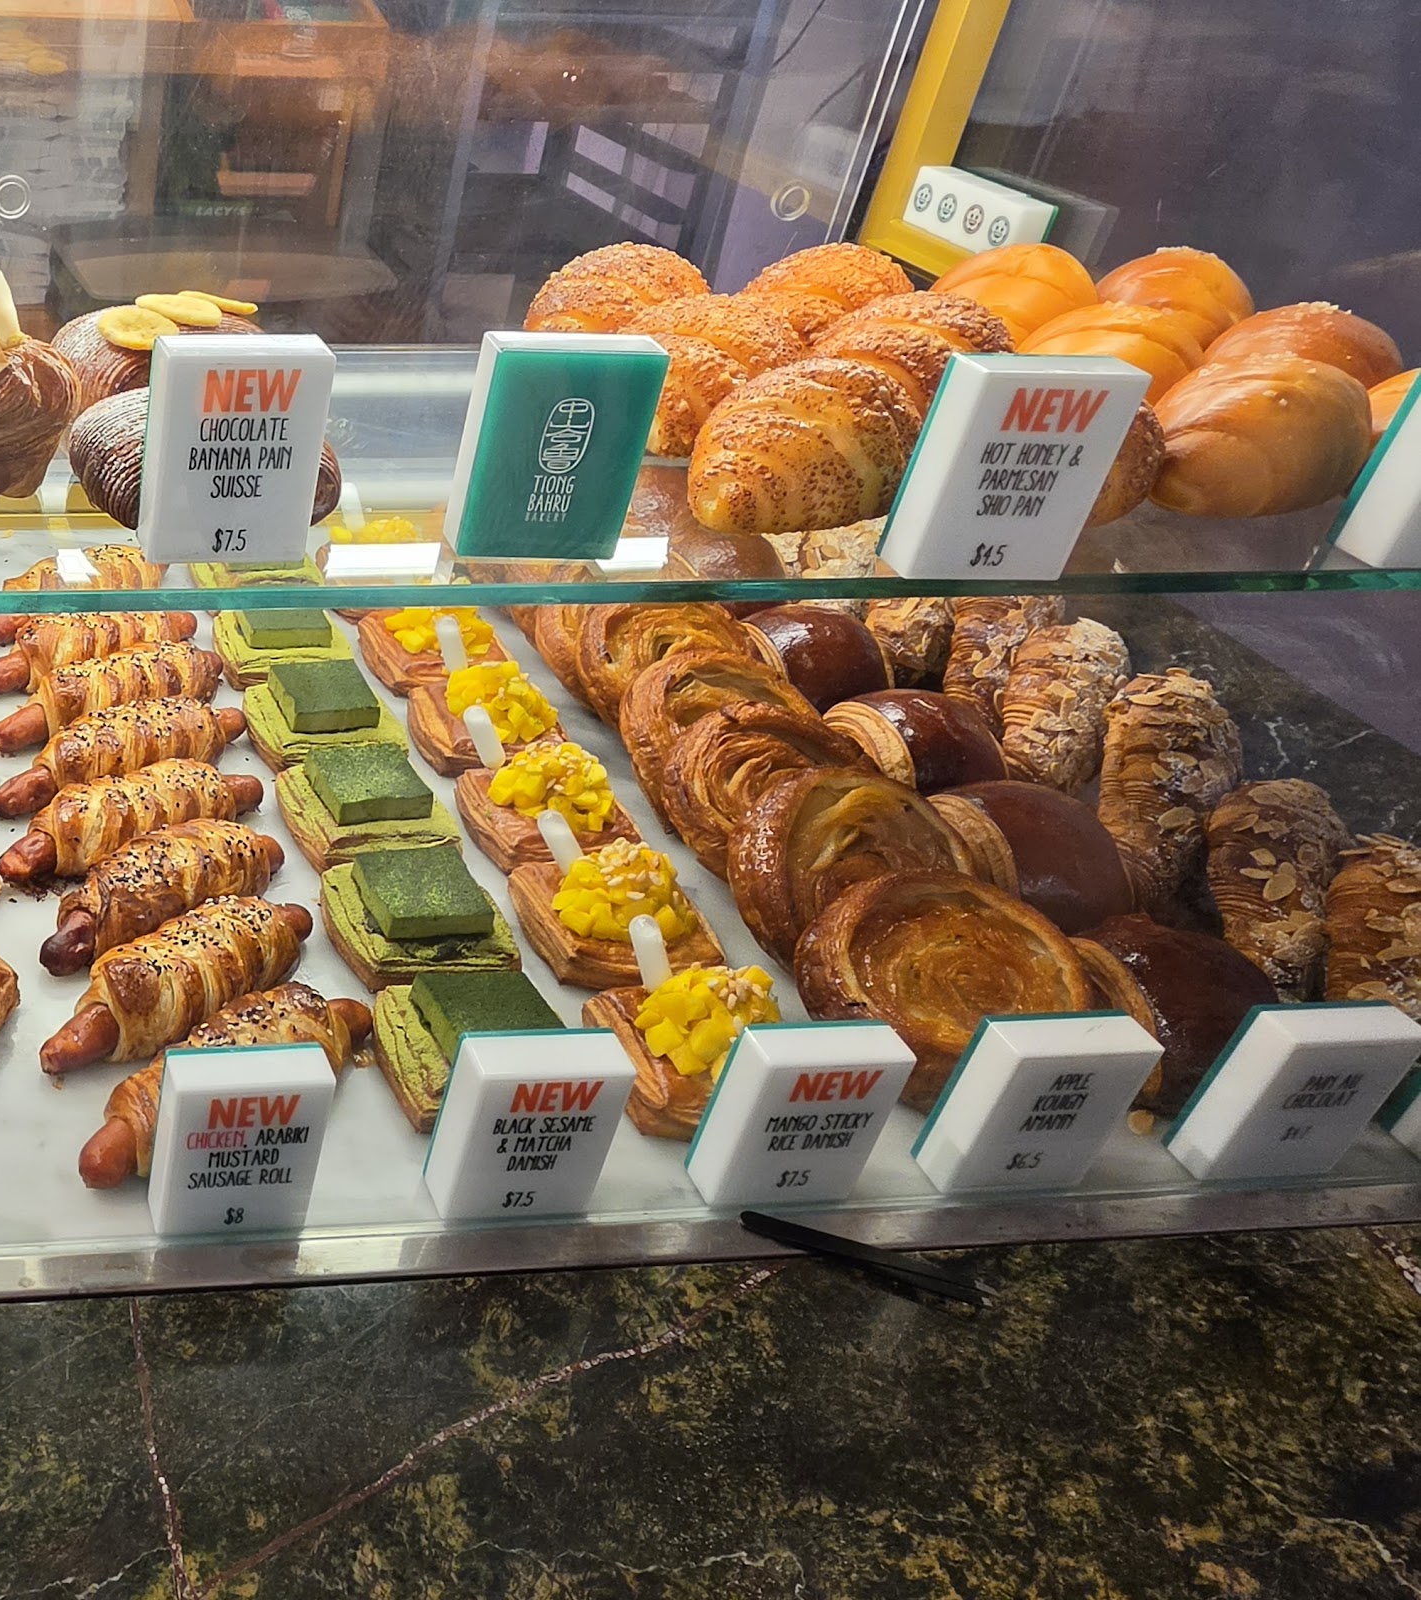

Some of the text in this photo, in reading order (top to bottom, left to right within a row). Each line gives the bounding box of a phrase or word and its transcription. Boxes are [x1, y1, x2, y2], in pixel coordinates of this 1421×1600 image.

[202, 368, 302, 413] NEW
[999, 387, 1111, 433] NEW
[200, 417, 290, 442] CHOCOLATE
[188, 446, 293, 471] BANANA PAIN
[980, 442, 1084, 467] HOT HONEY &
[210, 474, 263, 499] SUISSE
[534, 474, 577, 494] TIONG
[978, 469, 1059, 491] PARMESAN
[527, 493, 572, 513] BAHRU
[976, 495, 1046, 517] SHIO PAN
[524, 511, 568, 523] BAKERY
[212, 528, 247, 553] $7.5
[969, 543, 1008, 567] $4.5
[789, 1069, 883, 1103] NEW
[1049, 1073, 1095, 1091] APPLE
[509, 1080, 604, 1113] NEW
[1032, 1093, 1089, 1112] KOUIGN
[207, 1094, 301, 1130] NEW
[1020, 1113, 1077, 1131] AMANN
[492, 1115, 597, 1135] BLACK SESAME
[765, 1112, 874, 1133] MANGO STICKY
[255, 1126, 310, 1146] ARABIKI
[496, 1136, 571, 1154] & MATCHA
[767, 1132, 854, 1151] RICE DANISH
[208, 1148, 280, 1168] MUSTARD
[506, 1154, 558, 1171] DANISH
[187, 1167, 292, 1189] SAUSAGE ROLL
[776, 1169, 811, 1188] $7.5
[502, 1191, 536, 1208] $7.5
[223, 1207, 244, 1225] $8
